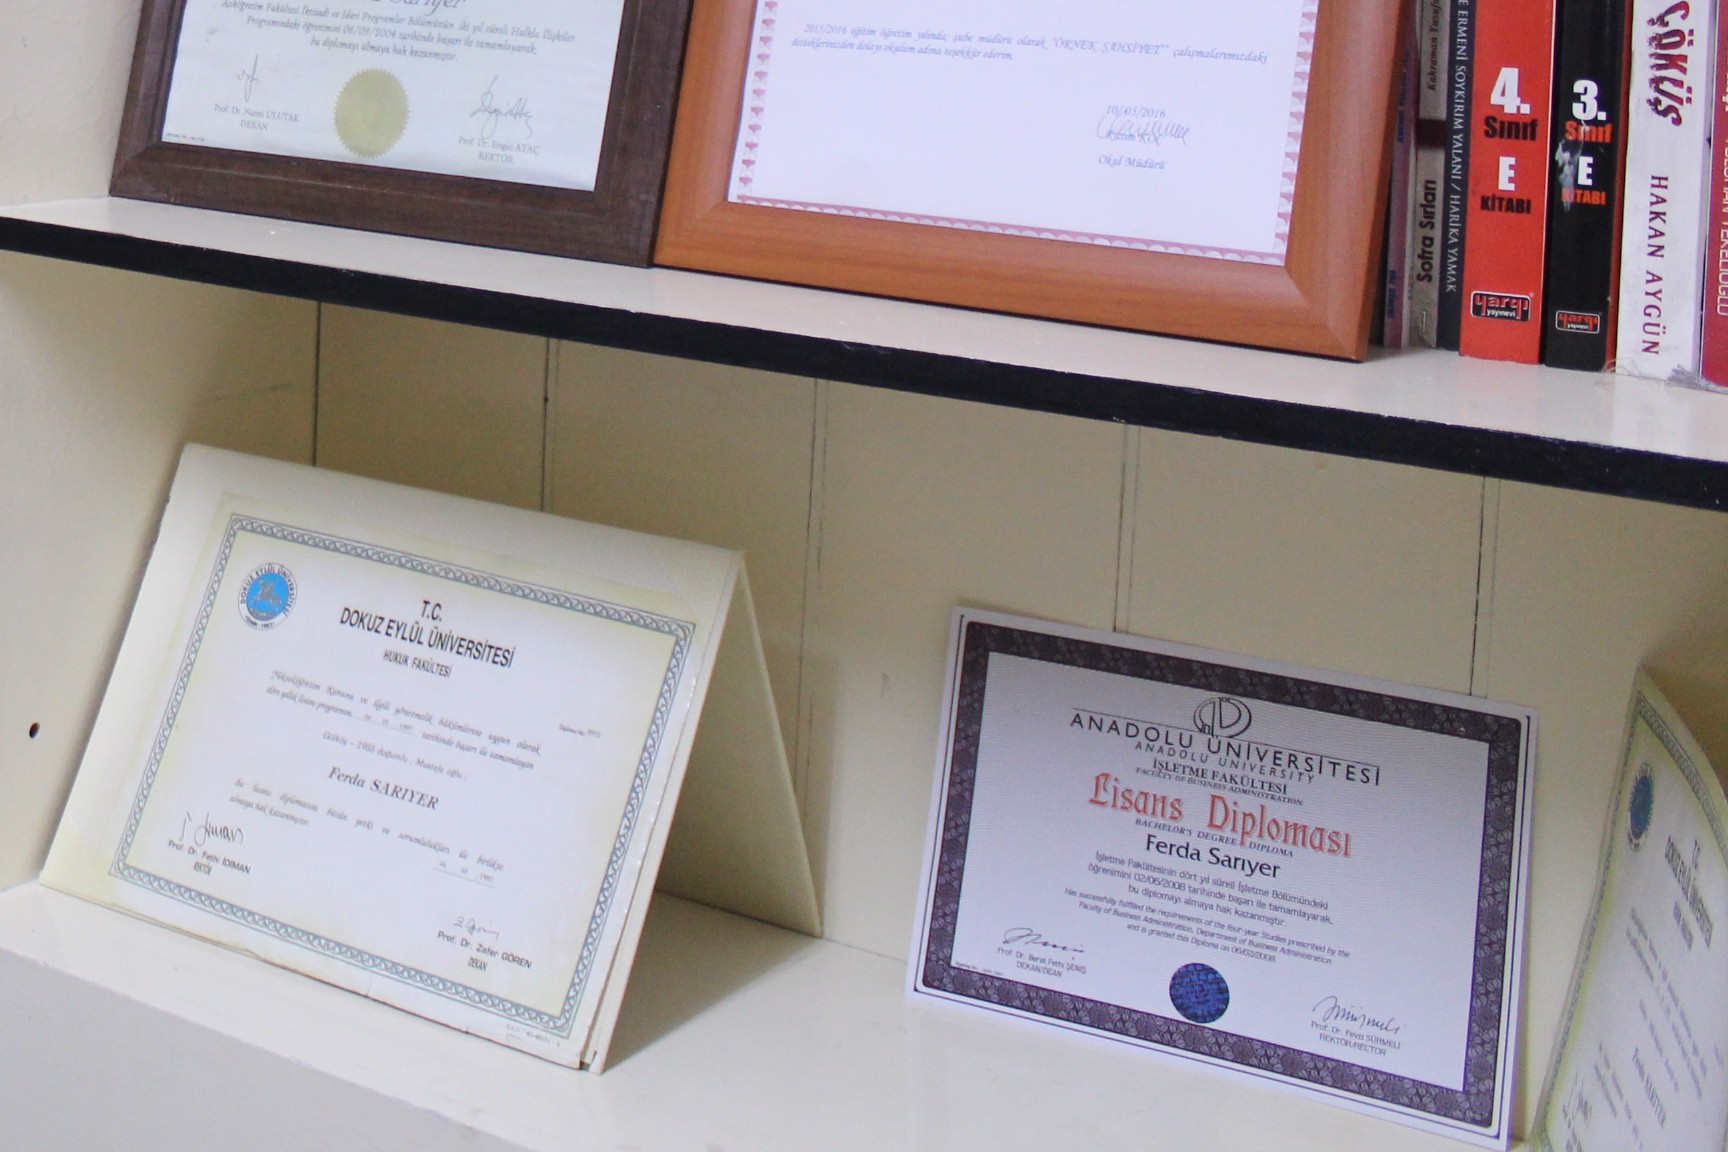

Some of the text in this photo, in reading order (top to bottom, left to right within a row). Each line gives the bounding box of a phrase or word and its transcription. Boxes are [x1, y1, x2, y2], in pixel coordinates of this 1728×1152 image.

[1455, 11, 1469, 61] ERMENİ
[1646, 0, 1694, 127] ÇÖKÜŞ
[1105, 104, 1166, 119] 10/05/2016
[1453, 64, 1467, 130] SOYKIRIM
[1490, 66, 1531, 114] 4.
[1572, 79, 1607, 121] 3.
[1484, 115, 1538, 141] Sınıf
[1565, 120, 1613, 143] Sınıf
[1450, 132, 1464, 180] YALANI
[1497, 155, 1516, 191] E
[1577, 155, 1594, 186] E
[1447, 194, 1462, 245] HARİKA
[1480, 194, 1531, 214] KİTABI
[1417, 235, 1434, 283] Sofra
[1445, 250, 1459, 293] YAMAK
[1641, 174, 1669, 355] HAKAN AYGÜN
[421, 599, 443, 622] T.C.
[340, 606, 516, 669] DOKUZ EYLÜL ÜNİVERSİTESİ
[382, 649, 452, 678] HUKUK FAKÜLTESİ
[1070, 712, 1380, 787] ANADOLU ÜNİVERSİTESİ
[1134, 740, 1316, 785] ANADOLU UNIVERSITY
[327, 764, 441, 811] Ferda SARIYER
[1152, 757, 1289, 795] İŞLETME FAKÜLTESİ
[1088, 771, 1353, 859] Lisans Diploması
[1145, 833, 1281, 879] Ferda Sarıyer
[1196, 830, 1237, 847] DEGREE
[1248, 841, 1294, 858] DIPLOMA
[437, 929, 532, 969] Prof. Zafer GÖREN
